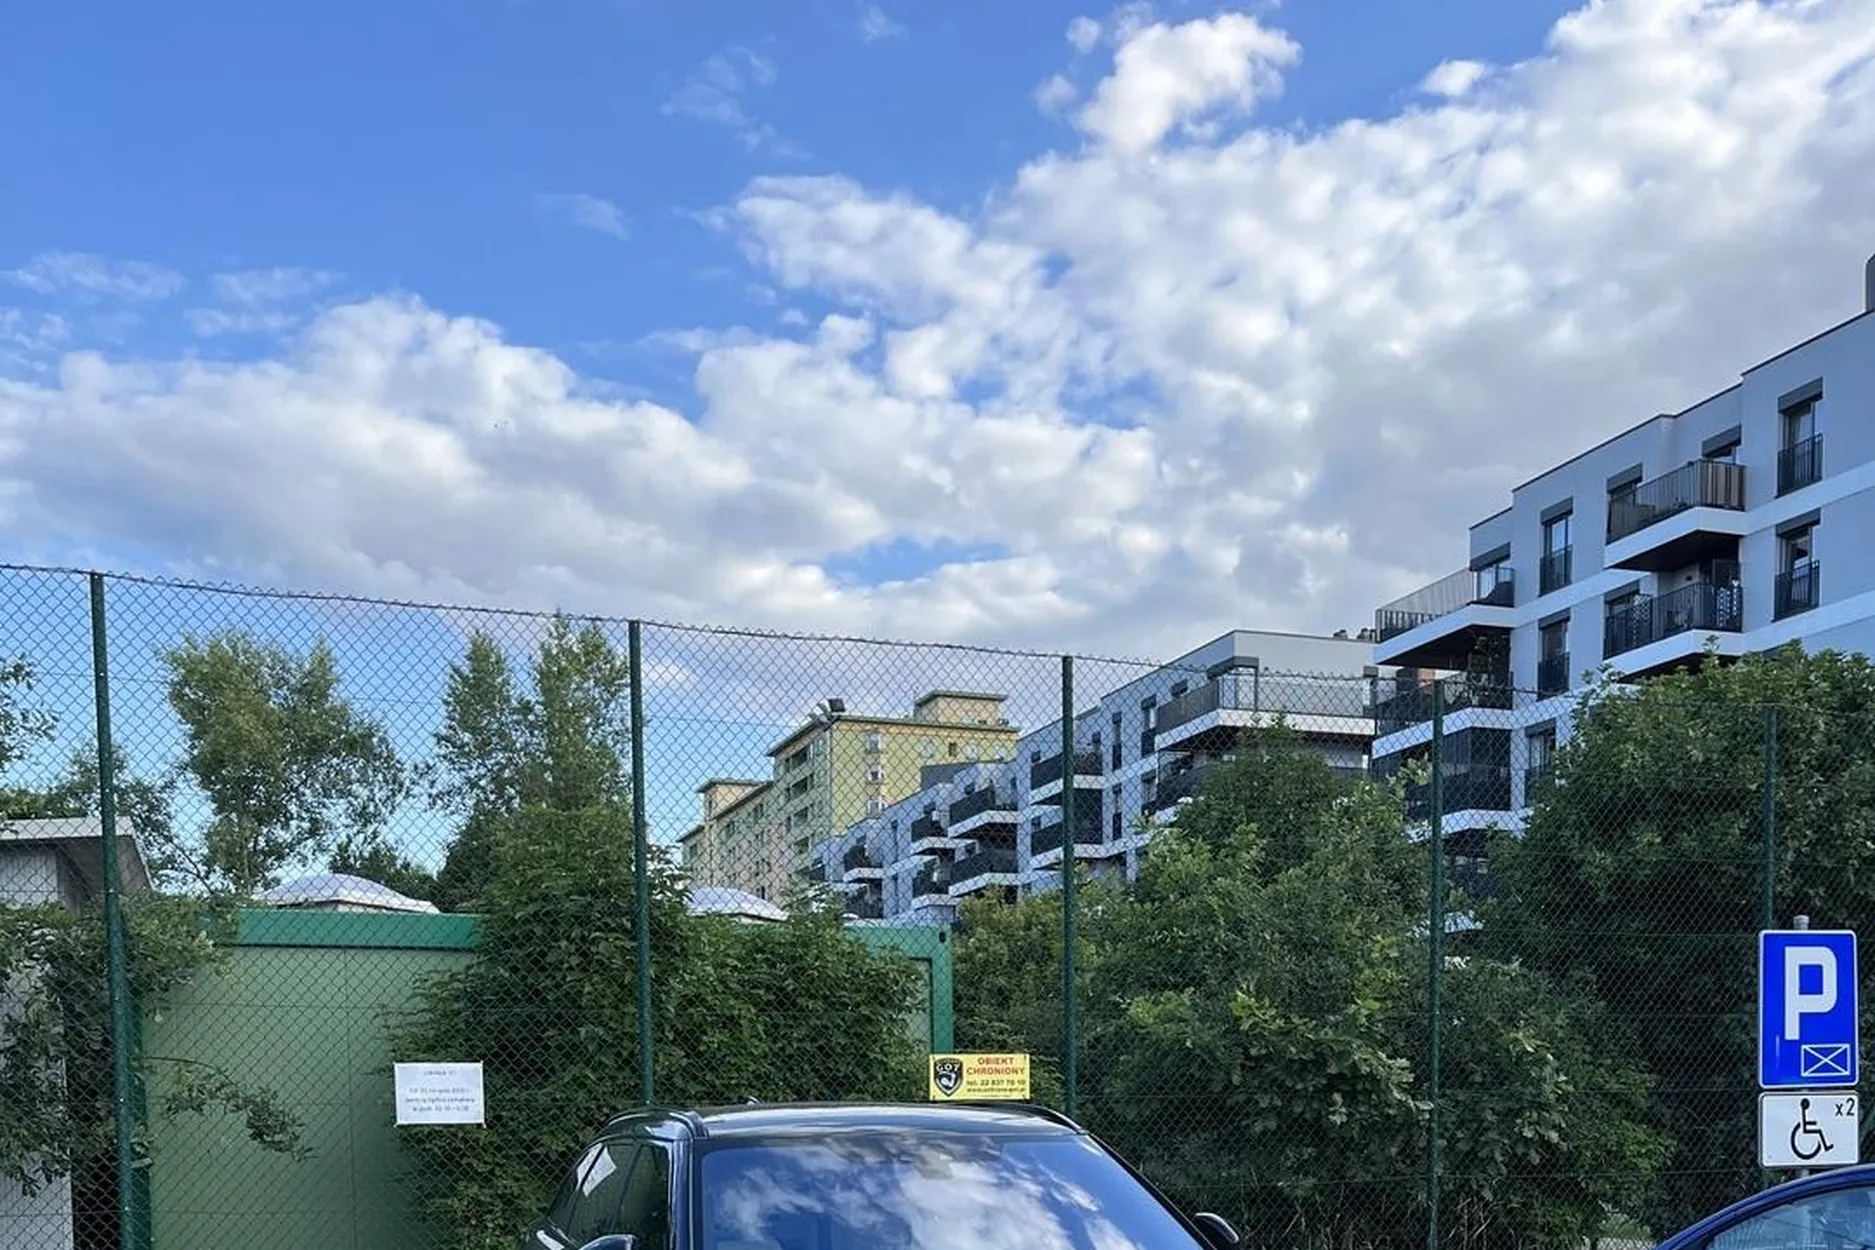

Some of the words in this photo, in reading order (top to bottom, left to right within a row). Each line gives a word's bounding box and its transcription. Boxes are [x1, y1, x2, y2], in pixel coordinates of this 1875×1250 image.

[1784, 945, 1838, 1040] P
[977, 1056, 1014, 1065] OBIEKT
[966, 1067, 1025, 1076] CHRONIONY
[1834, 1097, 1856, 1117] x2
